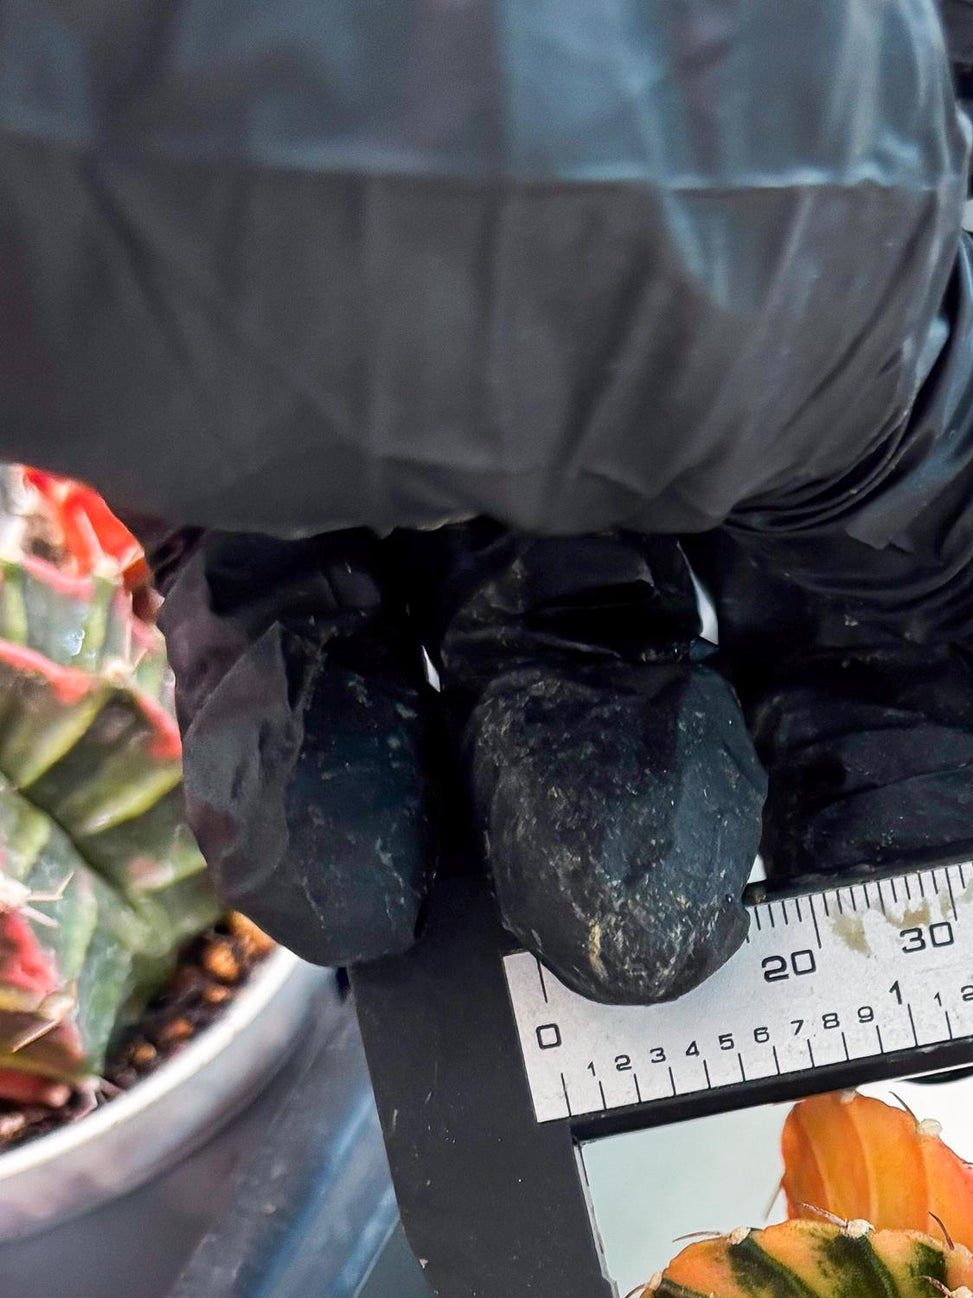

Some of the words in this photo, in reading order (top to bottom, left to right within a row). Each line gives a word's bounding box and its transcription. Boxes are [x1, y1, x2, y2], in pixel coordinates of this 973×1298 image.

[535, 1023, 562, 1050] 0
[761, 949, 817, 983] 20
[899, 921, 955, 954] 30
[614, 1054, 633, 1072] 2
[649, 1047, 667, 1064] 3
[685, 1040, 700, 1057] 4
[718, 1032, 735, 1051] 5
[753, 1026, 770, 1044] 6
[790, 1019, 804, 1036] 7
[821, 1012, 840, 1030] 8
[857, 1006, 874, 1024] 9
[888, 980, 903, 1005] 1
